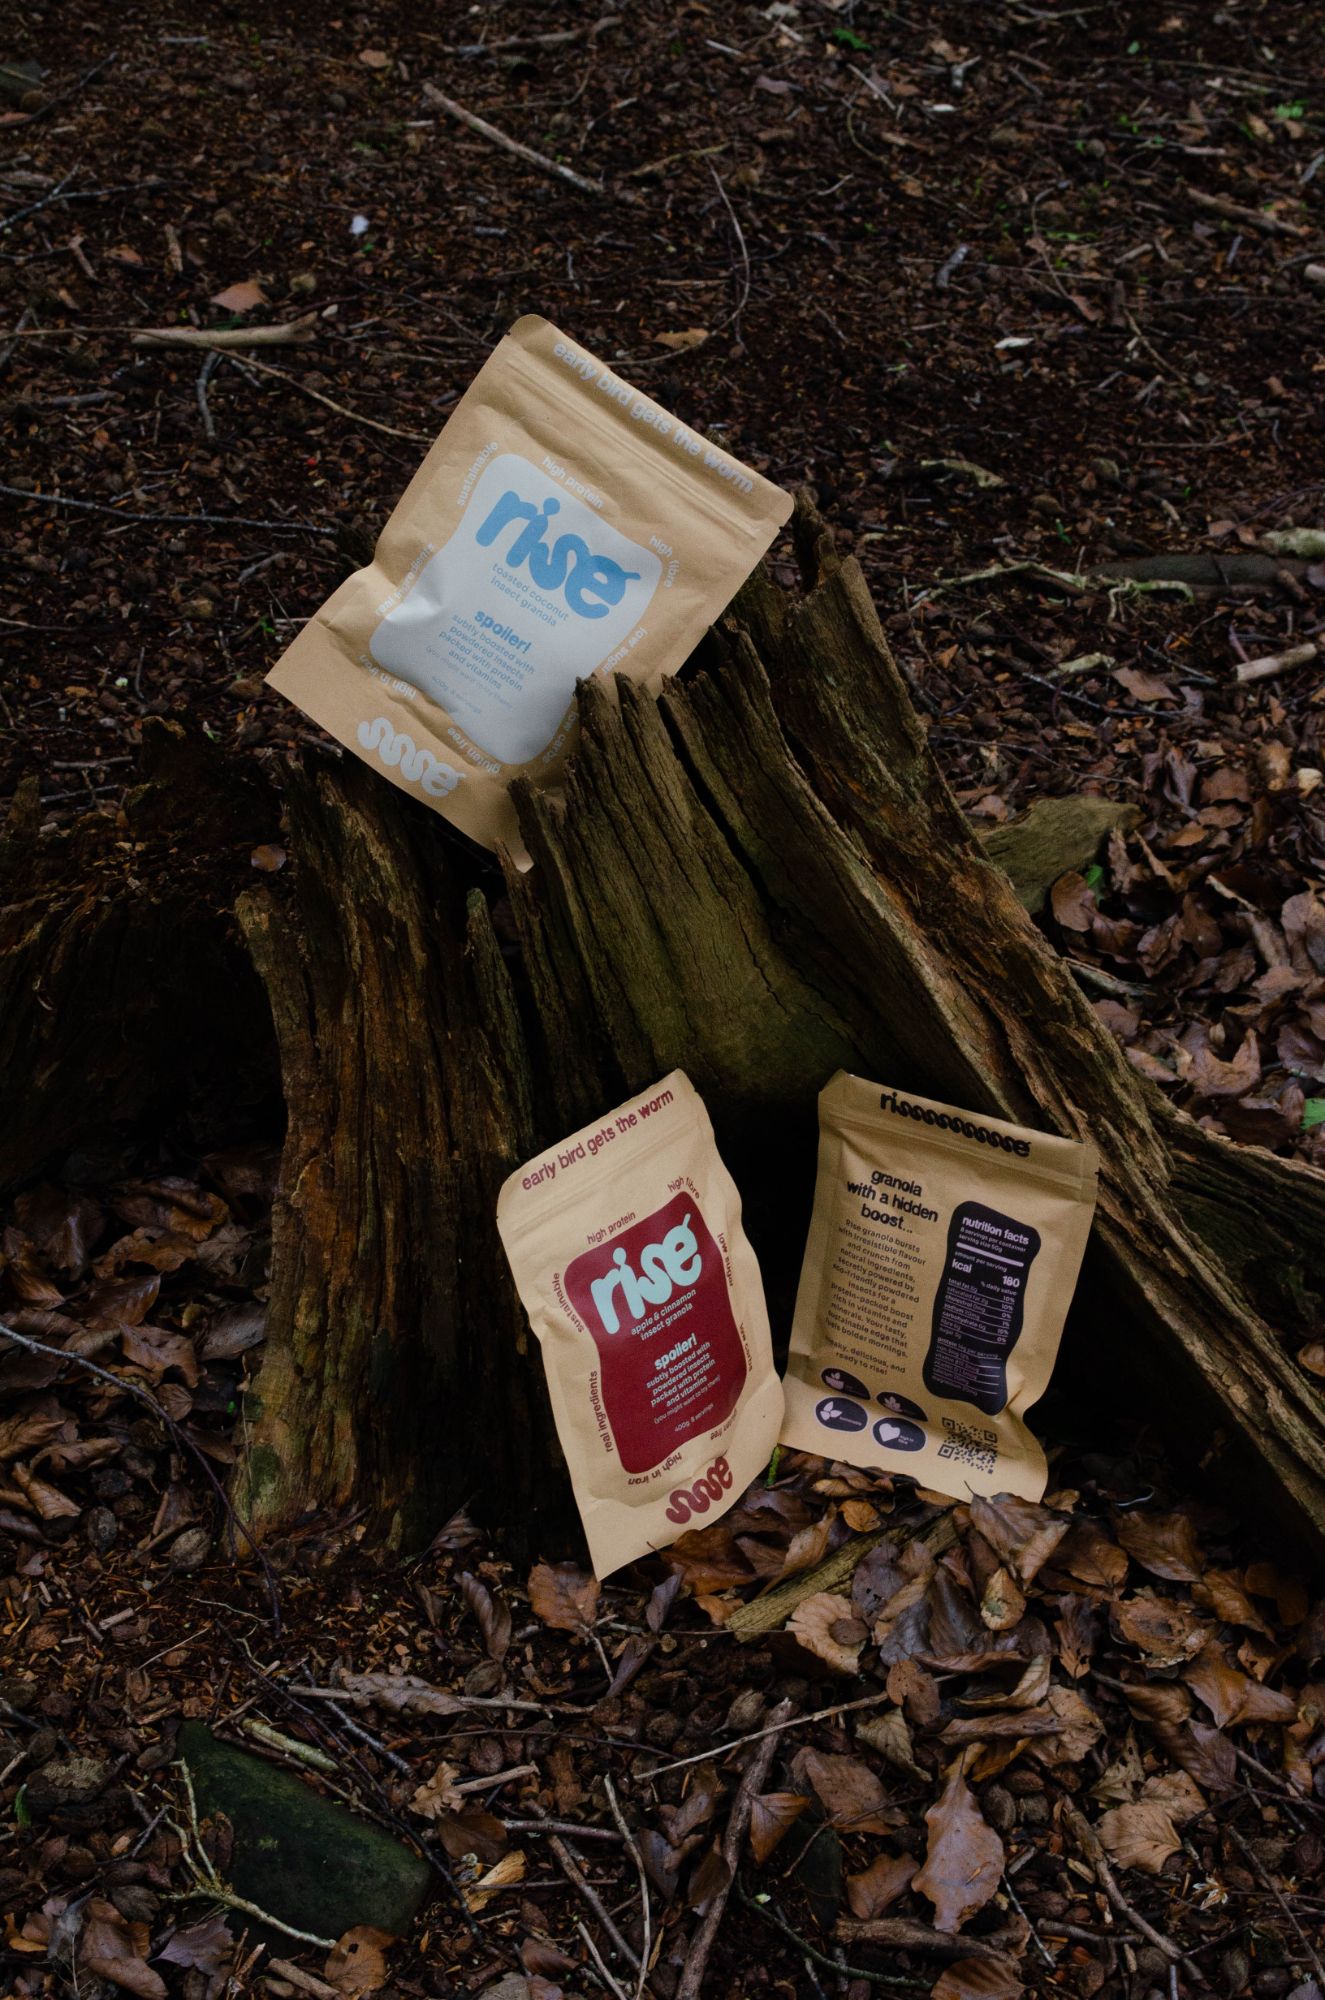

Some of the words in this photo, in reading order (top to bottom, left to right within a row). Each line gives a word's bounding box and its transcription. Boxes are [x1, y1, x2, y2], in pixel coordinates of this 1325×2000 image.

[553, 342, 599, 380] early
[595, 371, 634, 406] bird
[627, 398, 673, 438] gets
[671, 426, 704, 456] the
[705, 451, 753, 493] worm
[541, 455, 567, 479] high
[564, 476, 603, 510] protein
[476, 491, 641, 618] rise
[648, 534, 672, 556] high
[490, 575, 520, 601] insect
[519, 599, 556, 626] granola
[492, 563, 529, 592] toasted
[529, 590, 568, 620] coconut
[451, 614, 479, 636] subtly
[479, 631, 516, 660] boosted
[514, 658, 534, 674] with
[474, 611, 531, 653] spoiler!
[438, 631, 472, 655] packed
[471, 652, 491, 669] with
[490, 667, 522, 691] protein
[448, 625, 494, 657] powdered
[493, 655, 523, 679] insects
[448, 649, 466, 663] and
[465, 661, 501, 689] vitamins
[521, 1162, 555, 1190] early
[557, 1142, 586, 1168] bird
[587, 1127, 615, 1155] gets
[615, 1113, 637, 1132] the
[637, 1090, 673, 1118] worm
[667, 1176, 686, 1192] high
[870, 1170, 921, 1196] granola
[846, 1180, 875, 1200] with
[879, 1193, 888, 1204] a
[891, 1194, 937, 1222] hidden
[860, 1203, 912, 1233] boost...
[586, 1228, 607, 1244] high
[607, 1211, 635, 1234] protein
[717, 1232, 727, 1252] low
[845, 1219, 861, 1231] Rise
[861, 1227, 893, 1242] granola
[894, 1238, 919, 1253] bursts
[962, 1216, 1002, 1236] nutrition
[1003, 1228, 1029, 1244] facts
[838, 1226, 853, 1237] with
[852, 1233, 897, 1254] irresistible
[898, 1250, 926, 1265] flavour
[839, 1248, 865, 1262] natural
[847, 1241, 861, 1251] and
[861, 1247, 889, 1262] crunch
[891, 1257, 910, 1270] from
[590, 1213, 701, 1334] rise
[837, 1256, 866, 1274] secretly
[867, 1270, 903, 1287] powered
[904, 1282, 914, 1292] by
[951, 1258, 972, 1273] kcal
[1002, 1275, 1020, 1287] 180
[553, 1272, 584, 1332] sustainable
[848, 1280, 876, 1296] insects
[877, 1292, 889, 1301] for
[877, 1284, 919, 1303] powdered
[1000, 1303, 1013, 1312] 10%
[1003, 1295, 1015, 1303] 10%
[630, 1317, 653, 1335] apple
[653, 1312, 659, 1320] &
[660, 1289, 696, 1316] cinnamon
[640, 1320, 664, 1340] insect
[664, 1302, 692, 1326] granola
[831, 1293, 847, 1303] rich
[856, 1304, 890, 1322] vitamins
[891, 1318, 907, 1328] and
[866, 1317, 882, 1328] Your
[884, 1325, 906, 1338] tasty,
[889, 1307, 913, 1320] boost
[826, 1310, 868, 1332] sustainable
[869, 1329, 889, 1341] edge
[891, 1337, 907, 1348] that
[841, 1326, 867, 1341] bolder
[646, 1371, 668, 1388] subtly
[668, 1351, 696, 1374] boosted
[695, 1341, 710, 1354] with
[654, 1332, 697, 1370] spoiler!
[835, 1351, 858, 1364] ready
[850, 1348, 888, 1367] delicious,
[890, 1364, 905, 1373] and
[650, 1385, 677, 1407] packed
[677, 1375, 692, 1389] with
[692, 1358, 715, 1379] protein
[652, 1368, 687, 1396] powdered
[686, 1352, 709, 1371] insects
[666, 1393, 680, 1406] and
[679, 1375, 707, 1397] vitamins
[589, 1372, 606, 1431] ingredients
[599, 1434, 612, 1451] real
[651, 1469, 661, 1478] in
[659, 1452, 682, 1470] high
[628, 1475, 648, 1485] iron
